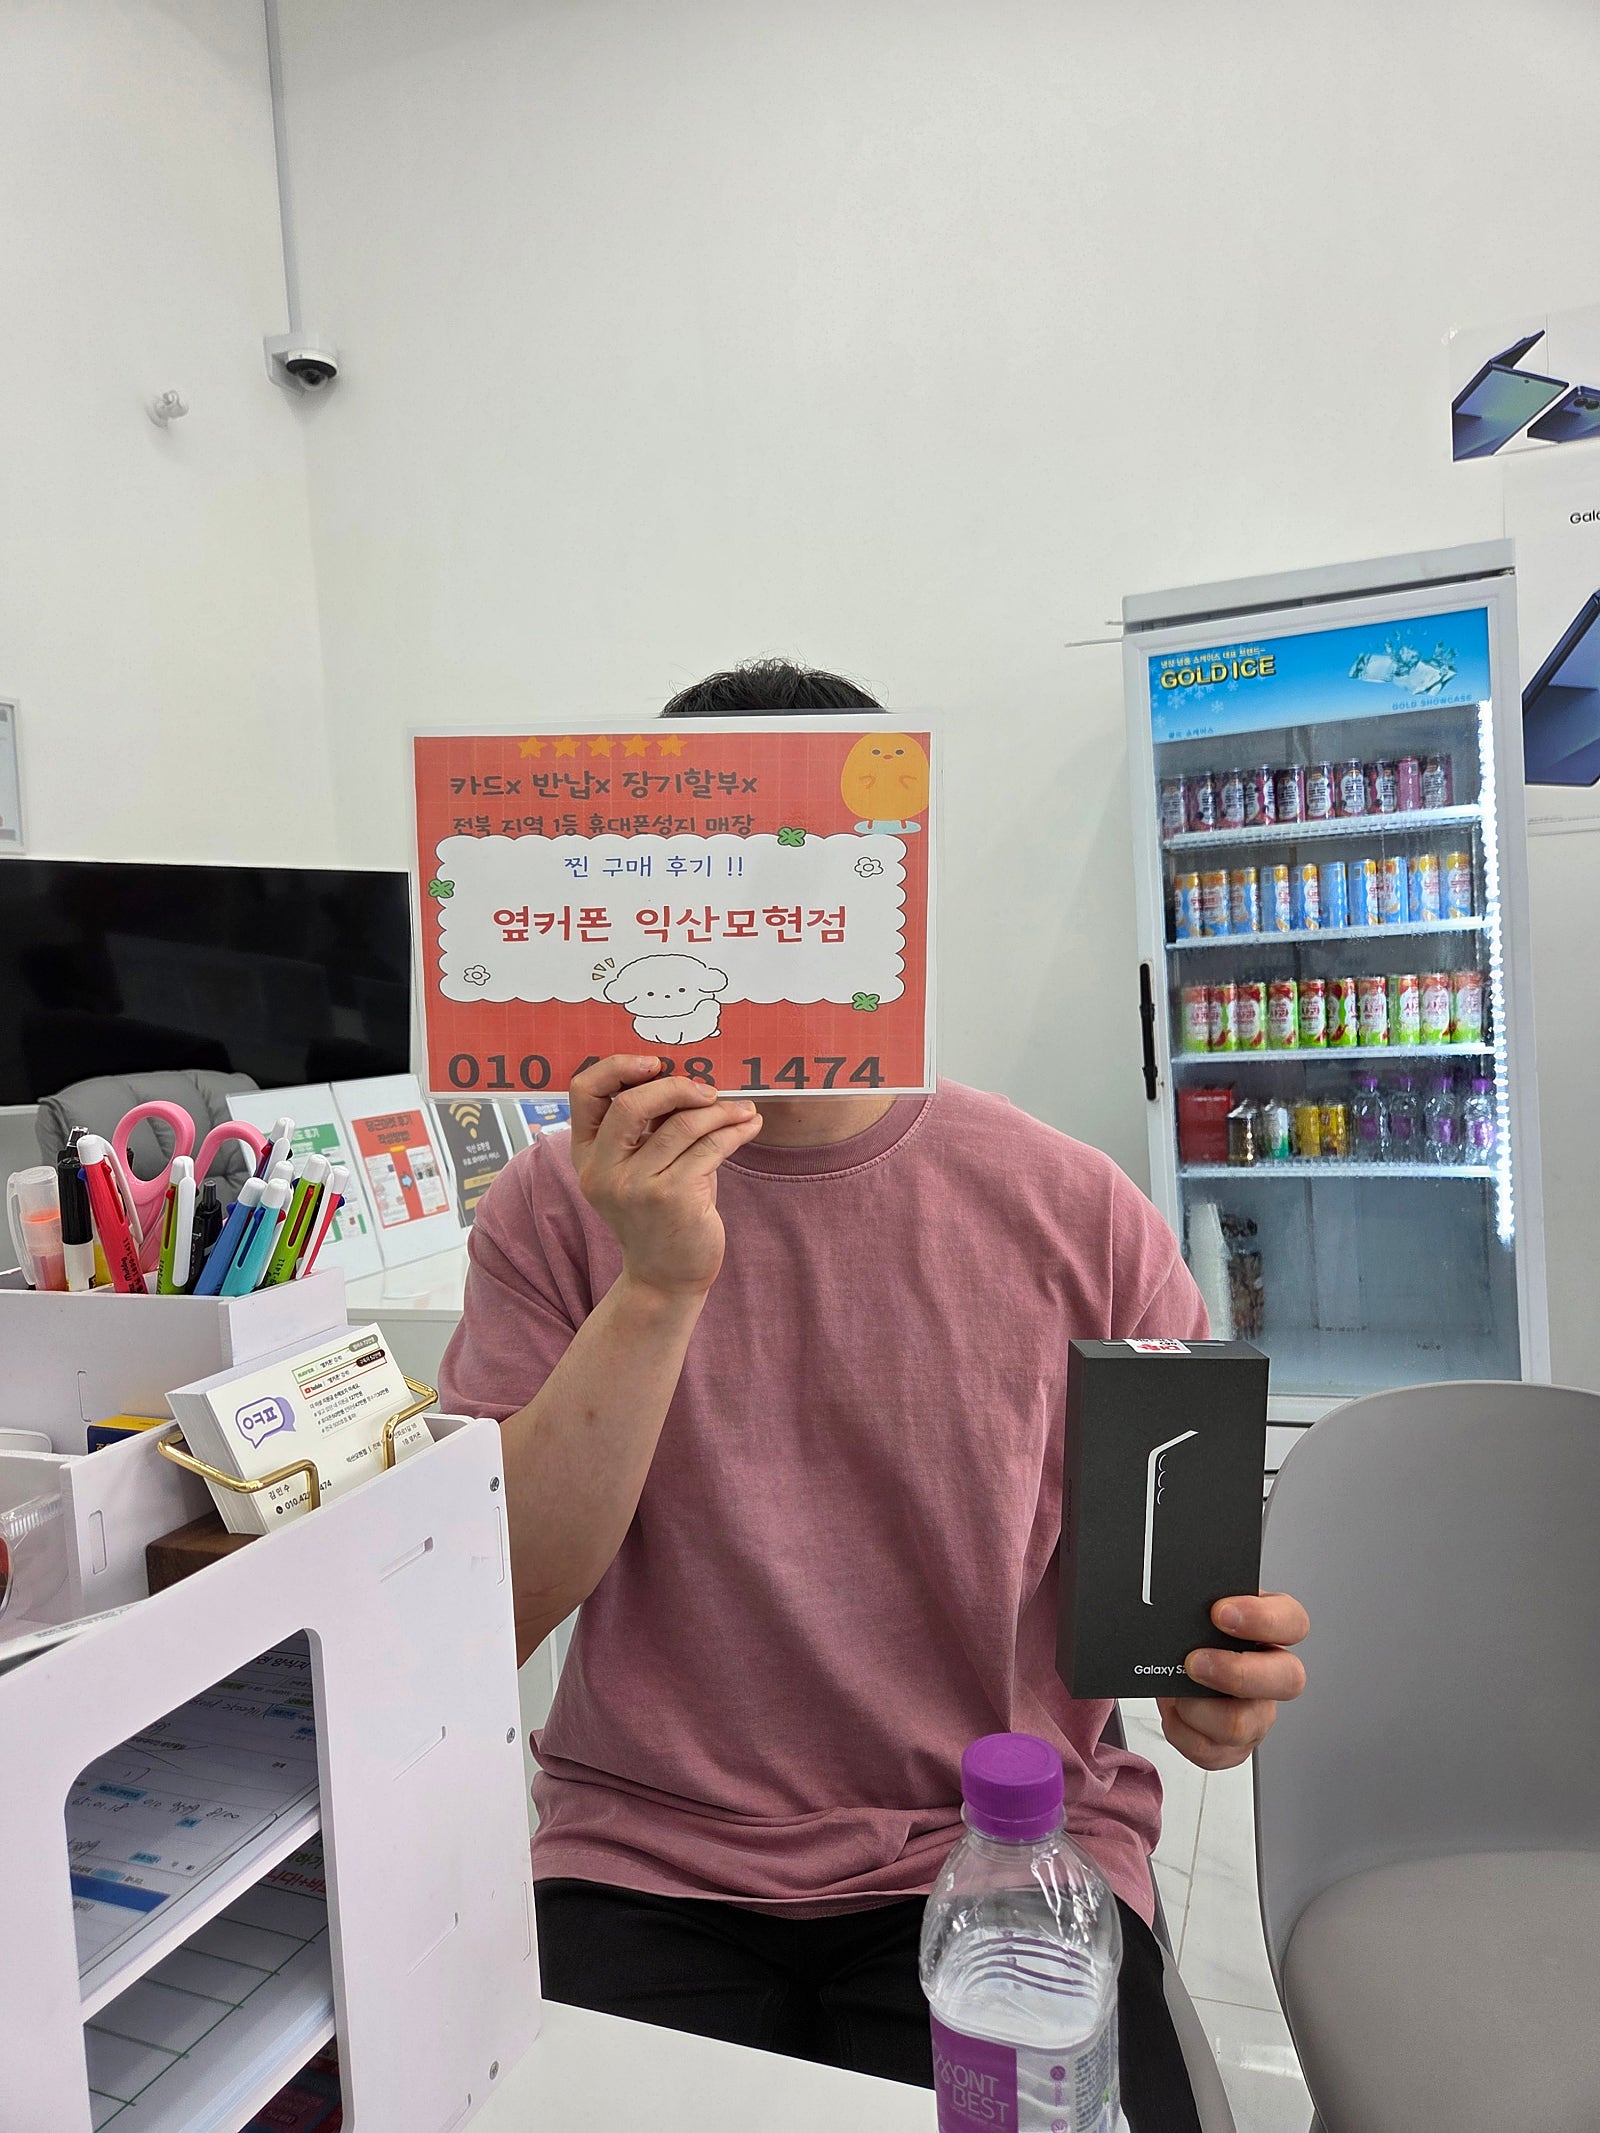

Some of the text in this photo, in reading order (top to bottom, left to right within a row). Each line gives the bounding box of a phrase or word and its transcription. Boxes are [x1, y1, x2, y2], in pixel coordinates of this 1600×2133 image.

[1160, 654, 1277, 690] GOLD ICE
[1391, 694, 1473, 712] GOLD SHOWCASE
[453, 813, 756, 835] 전북 지역 1등 휴대폰성지 매장
[563, 854, 744, 879] 찐 구매 후기 !!
[492, 904, 848, 944] 옆커폰 익산모현점
[448, 1053, 551, 1090] 010
[740, 1055, 886, 1090] 1474
[1134, 1664, 1175, 1677] Galaxy
[952, 2083, 1010, 2123] BEST
